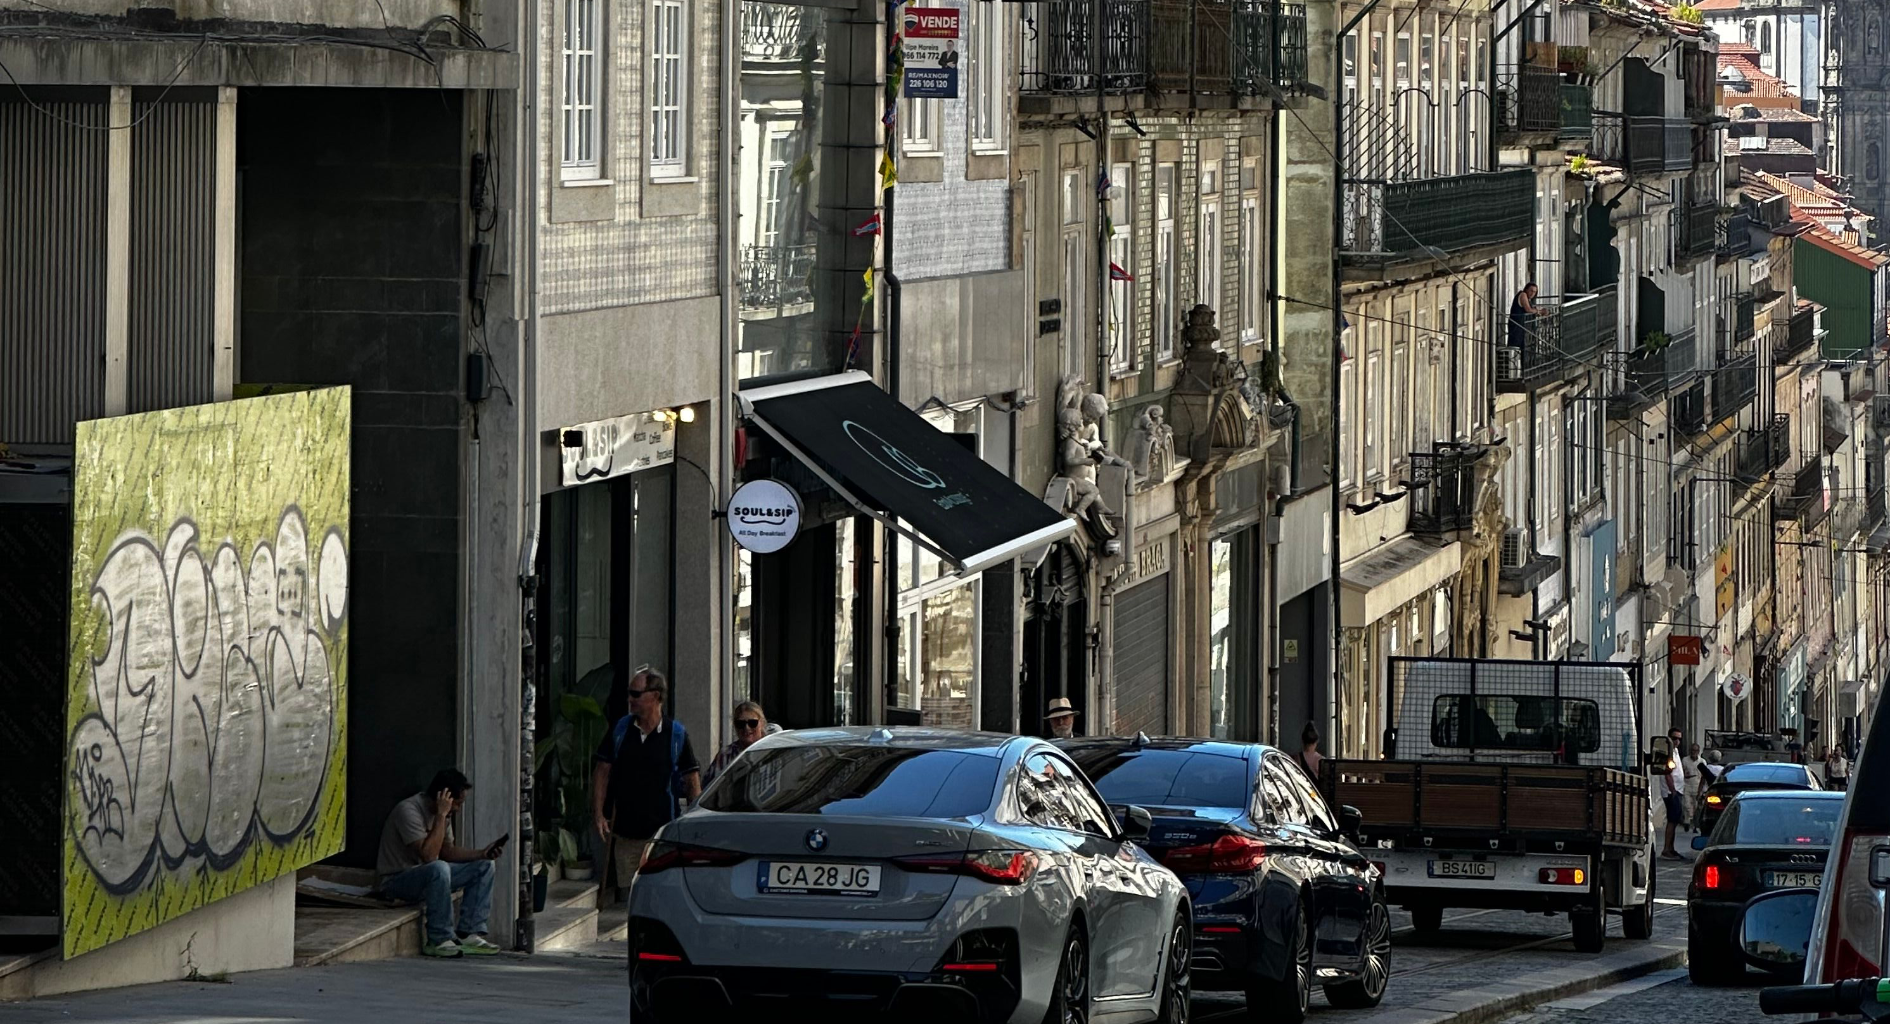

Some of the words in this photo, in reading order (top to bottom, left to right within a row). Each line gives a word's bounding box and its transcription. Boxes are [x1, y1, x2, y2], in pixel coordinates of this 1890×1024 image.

[920, 16, 958, 28] VENDE
[918, 43, 938, 51] Moreira
[909, 79, 922, 88] 226
[923, 80, 934, 88] 106
[936, 80, 948, 88] 120
[734, 506, 793, 517] SOUL&SIP
[777, 865, 809, 886] CA
[813, 866, 839, 887] 28
[842, 867, 870, 888] JG
